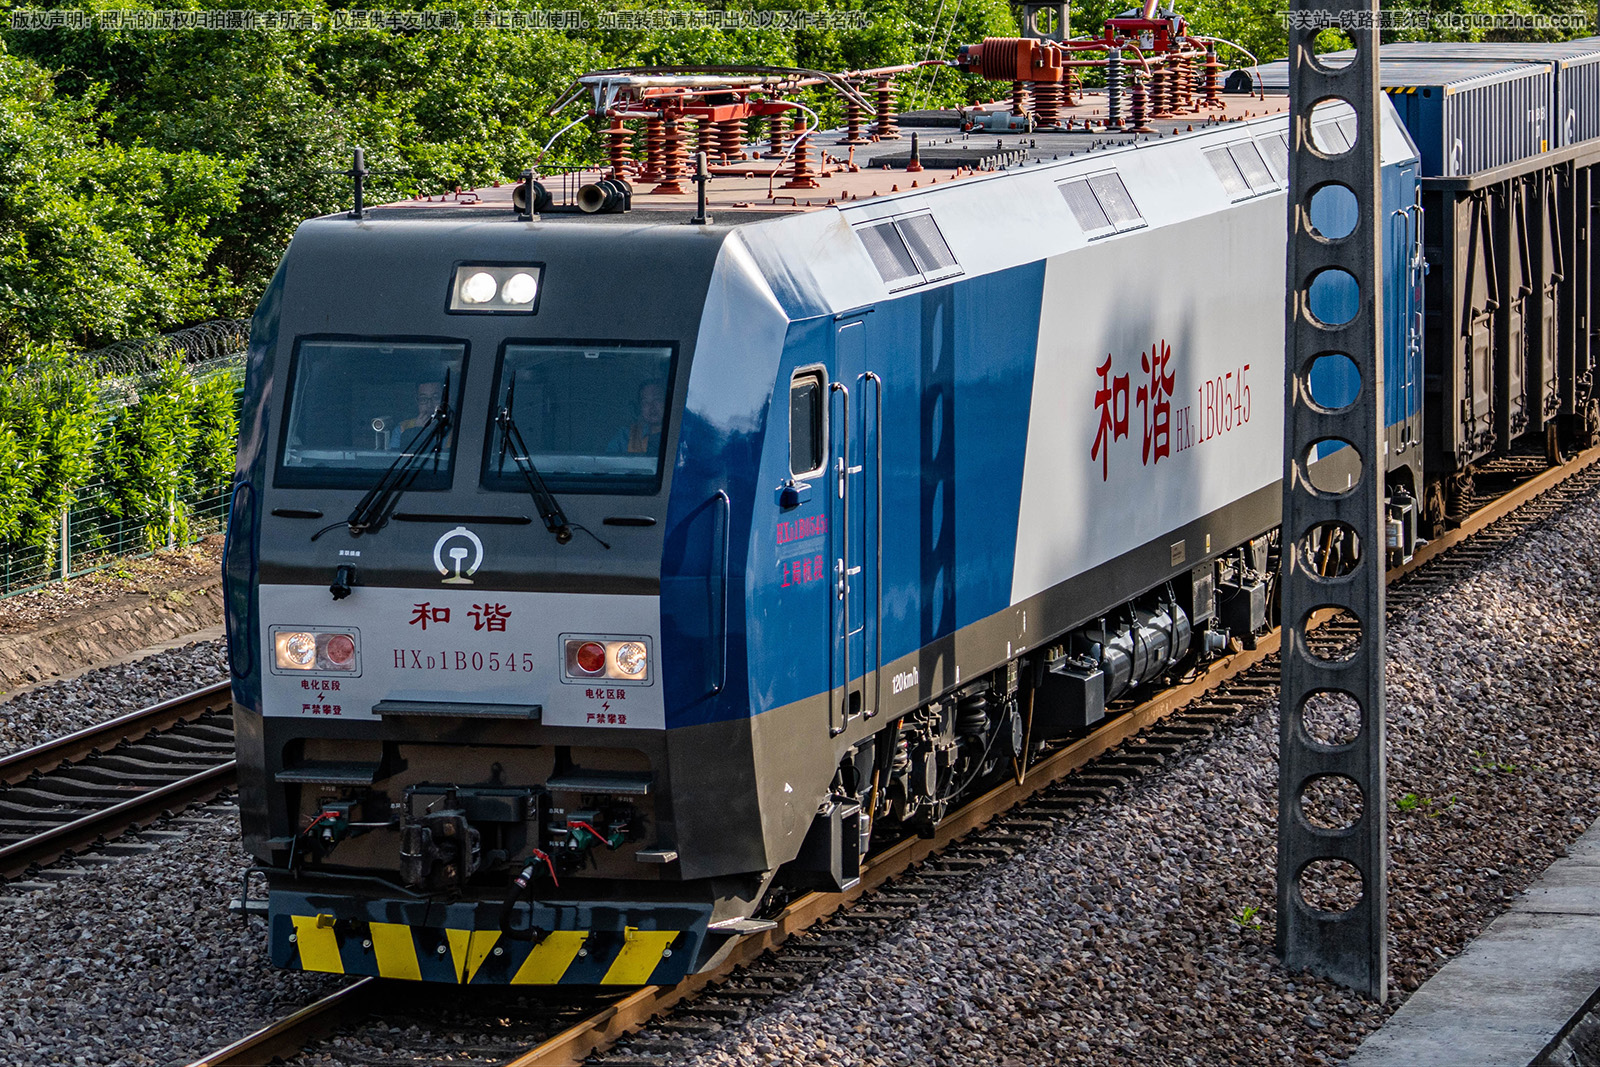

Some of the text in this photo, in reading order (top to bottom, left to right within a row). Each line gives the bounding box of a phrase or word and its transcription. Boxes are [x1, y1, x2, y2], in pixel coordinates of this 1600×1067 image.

[1091, 339, 1175, 482] 和谐
[781, 555, 823, 587] 上局杭段
[409, 602, 512, 632] 和谐
[301, 679, 341, 690] 电化区段
[585, 688, 626, 699] 电化区段
[302, 704, 342, 715] 严禁攀登
[586, 713, 627, 724] 严禁攀登
